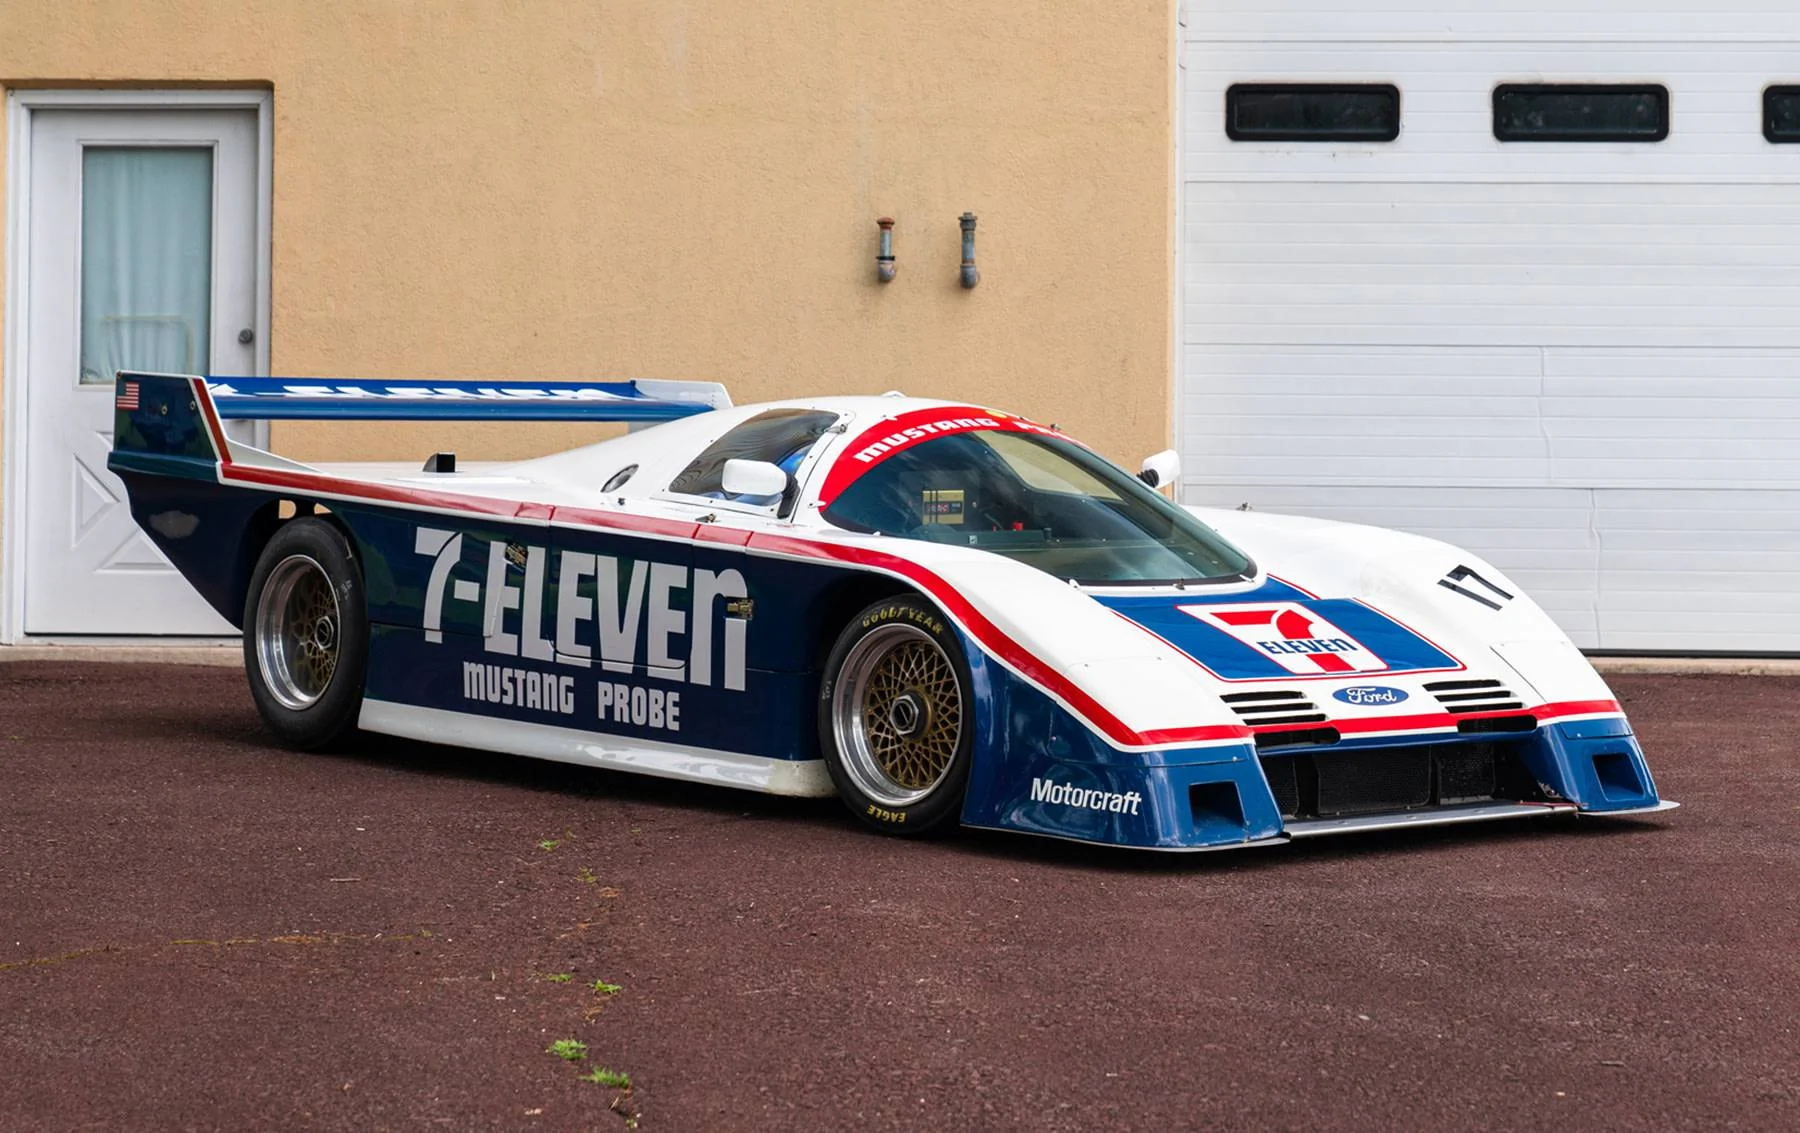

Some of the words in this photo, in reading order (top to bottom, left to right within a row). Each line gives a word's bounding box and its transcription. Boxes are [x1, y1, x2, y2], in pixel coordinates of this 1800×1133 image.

[853, 416, 1000, 463] MUSTANG
[1437, 564, 1514, 611] 17
[463, 661, 574, 714] MUSTANG
[597, 682, 680, 731] PROBE
[1346, 687, 1398, 704] Ford
[866, 804, 906, 823] EAGLE
[1030, 777, 1142, 816] Motorcraft
